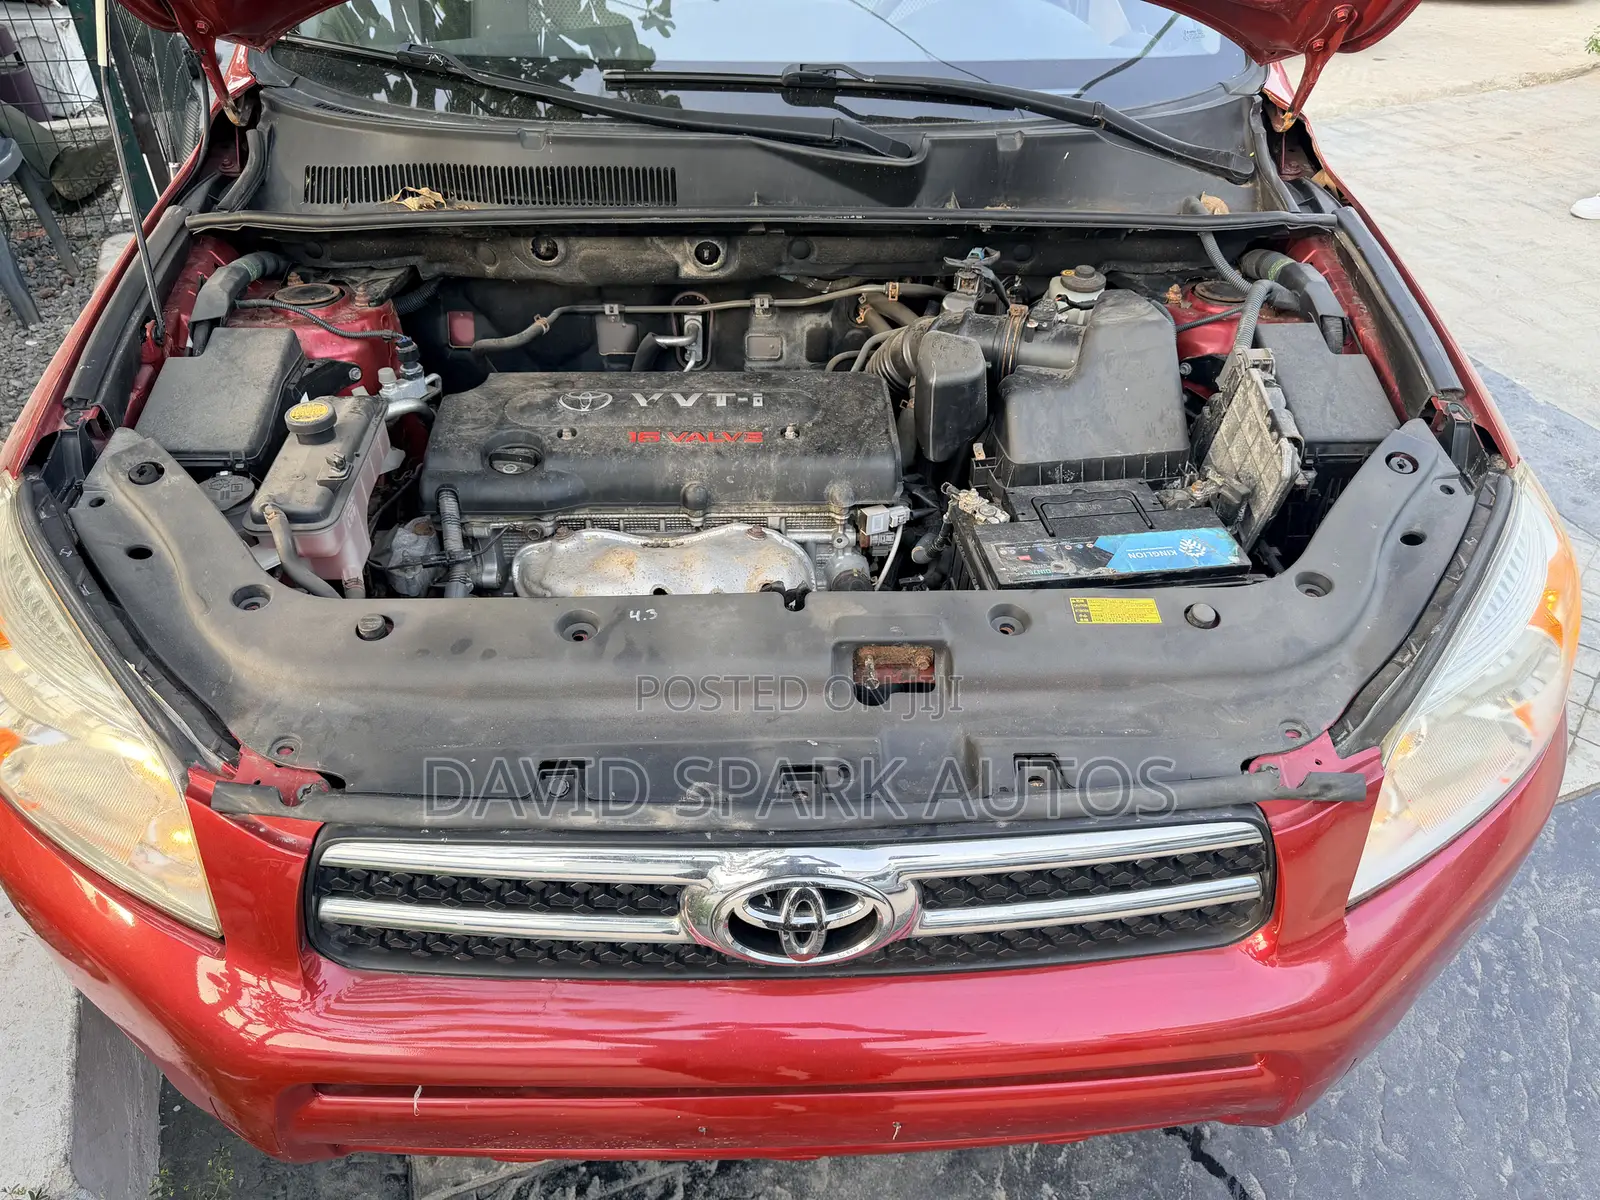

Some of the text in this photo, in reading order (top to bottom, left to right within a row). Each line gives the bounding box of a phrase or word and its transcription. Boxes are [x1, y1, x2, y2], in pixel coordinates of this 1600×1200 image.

[628, 430, 763, 443] 16 VALVE
[1127, 548, 1178, 560] KINGLION
[629, 608, 658, 621] 4.3
